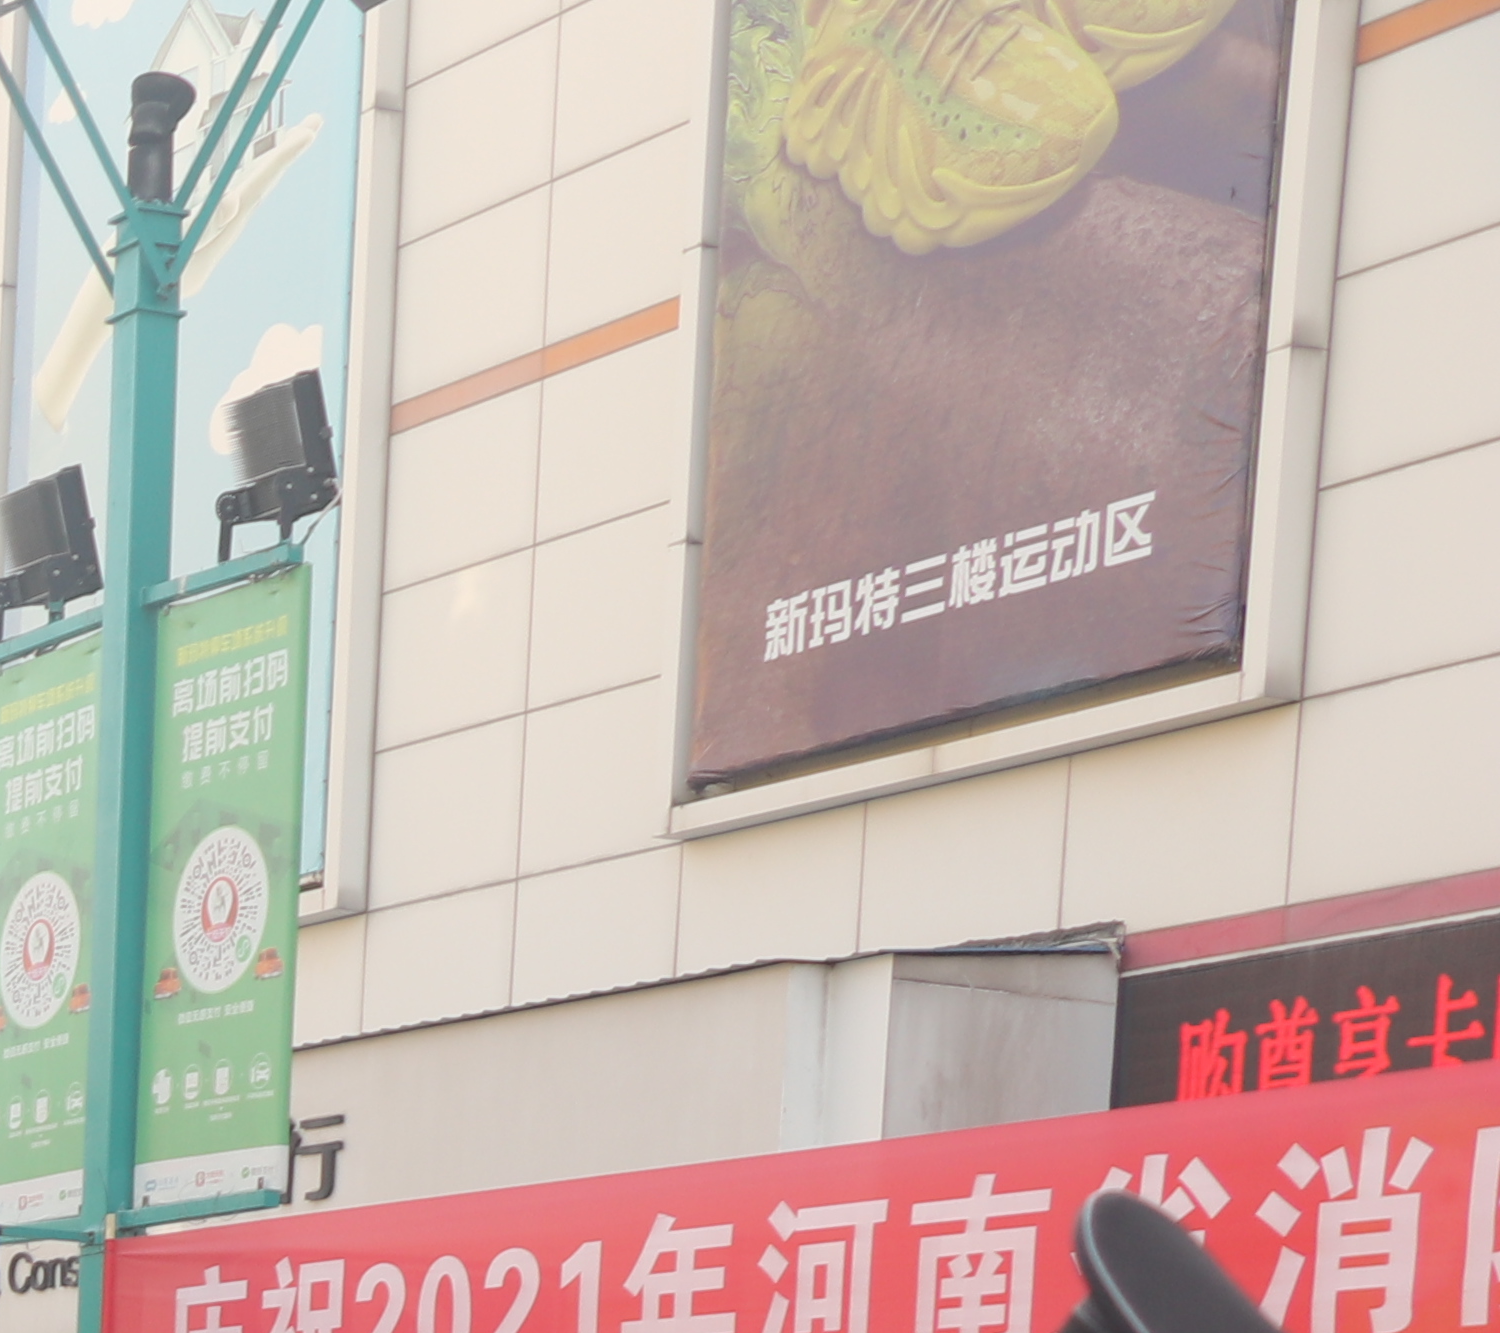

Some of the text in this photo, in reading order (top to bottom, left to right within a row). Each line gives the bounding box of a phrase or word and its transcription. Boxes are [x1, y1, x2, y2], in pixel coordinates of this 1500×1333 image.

[763, 491, 1156, 662] 新玛特三楼运动区
[172, 648, 288, 718] 离场前扫码
[182, 702, 274, 763] 提前支付
[5, 754, 83, 815] 提前支付
[1177, 973, 1500, 1101] 购尊享卡
